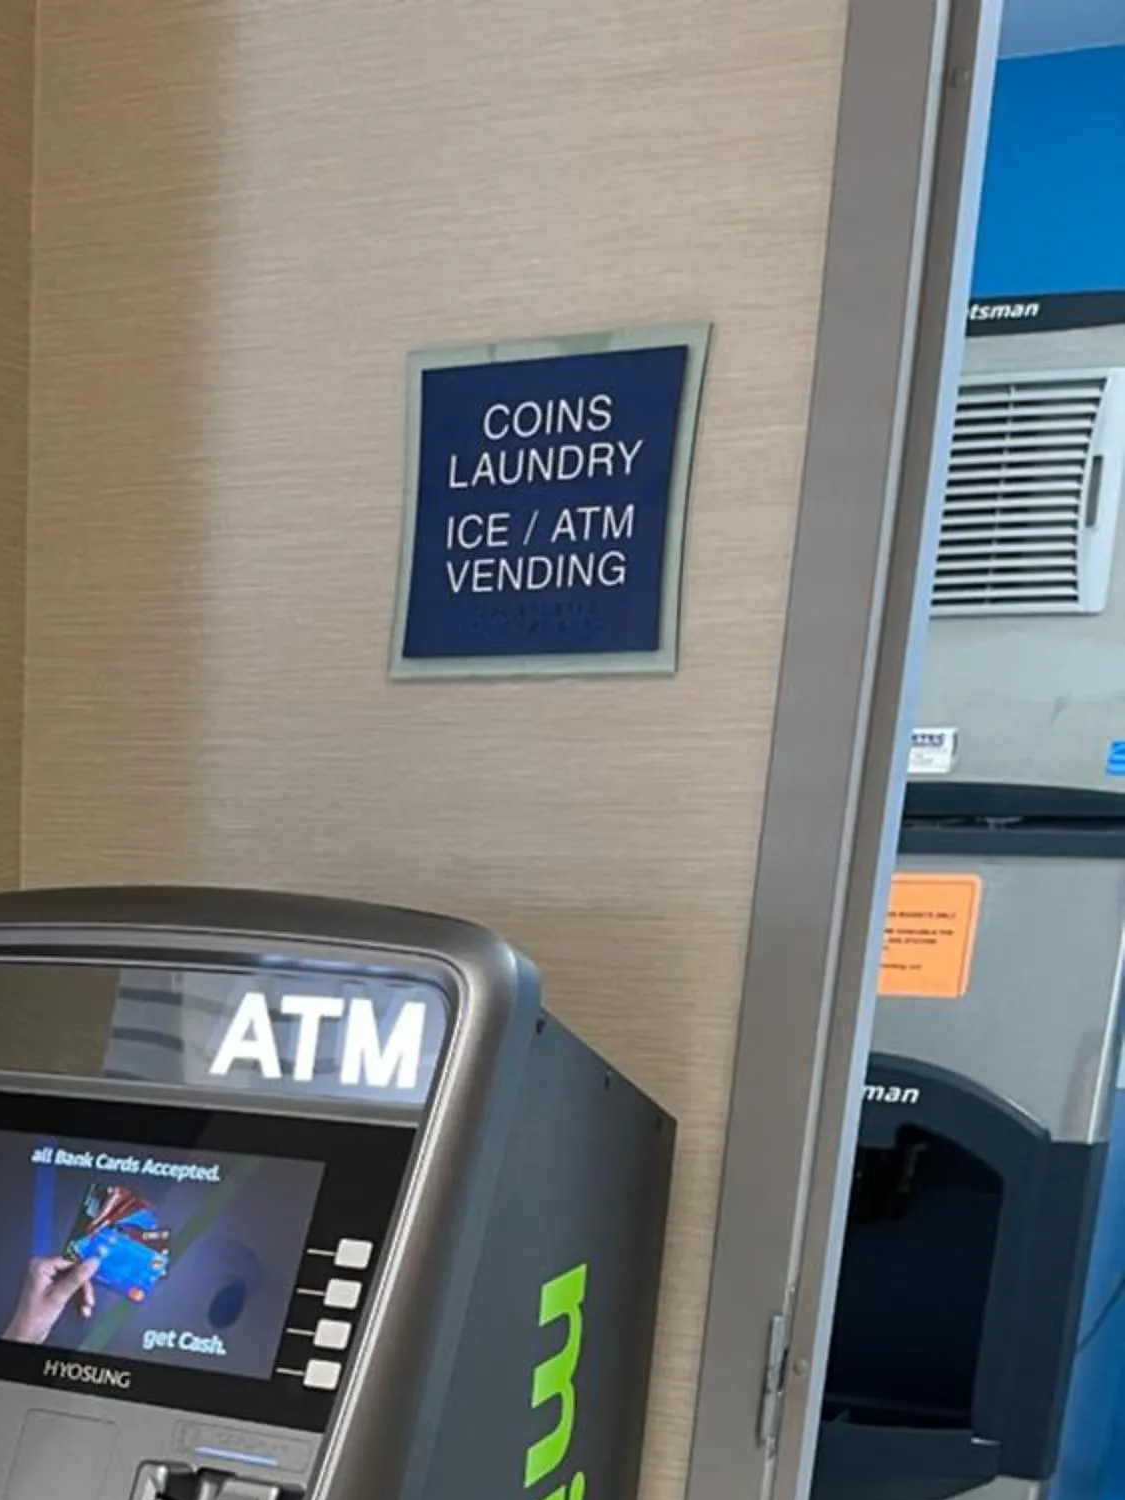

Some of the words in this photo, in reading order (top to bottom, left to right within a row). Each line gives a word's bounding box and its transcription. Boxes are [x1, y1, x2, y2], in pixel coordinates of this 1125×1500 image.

[483, 394, 613, 440] COINS
[448, 440, 644, 489] LAUNDRY
[446, 512, 511, 550] ICE
[522, 510, 540, 546] /
[550, 504, 635, 543] ATM
[446, 551, 627, 593] VENDING
[209, 992, 426, 1089] ATM
[31, 1147, 52, 1164] all
[54, 1149, 94, 1169] Bank
[95, 1153, 141, 1174] Cards
[142, 1158, 221, 1183] Accepted.
[142, 1328, 176, 1350] get
[178, 1331, 227, 1356] Cash.
[43, 1359, 132, 1389] HYOSUNG
